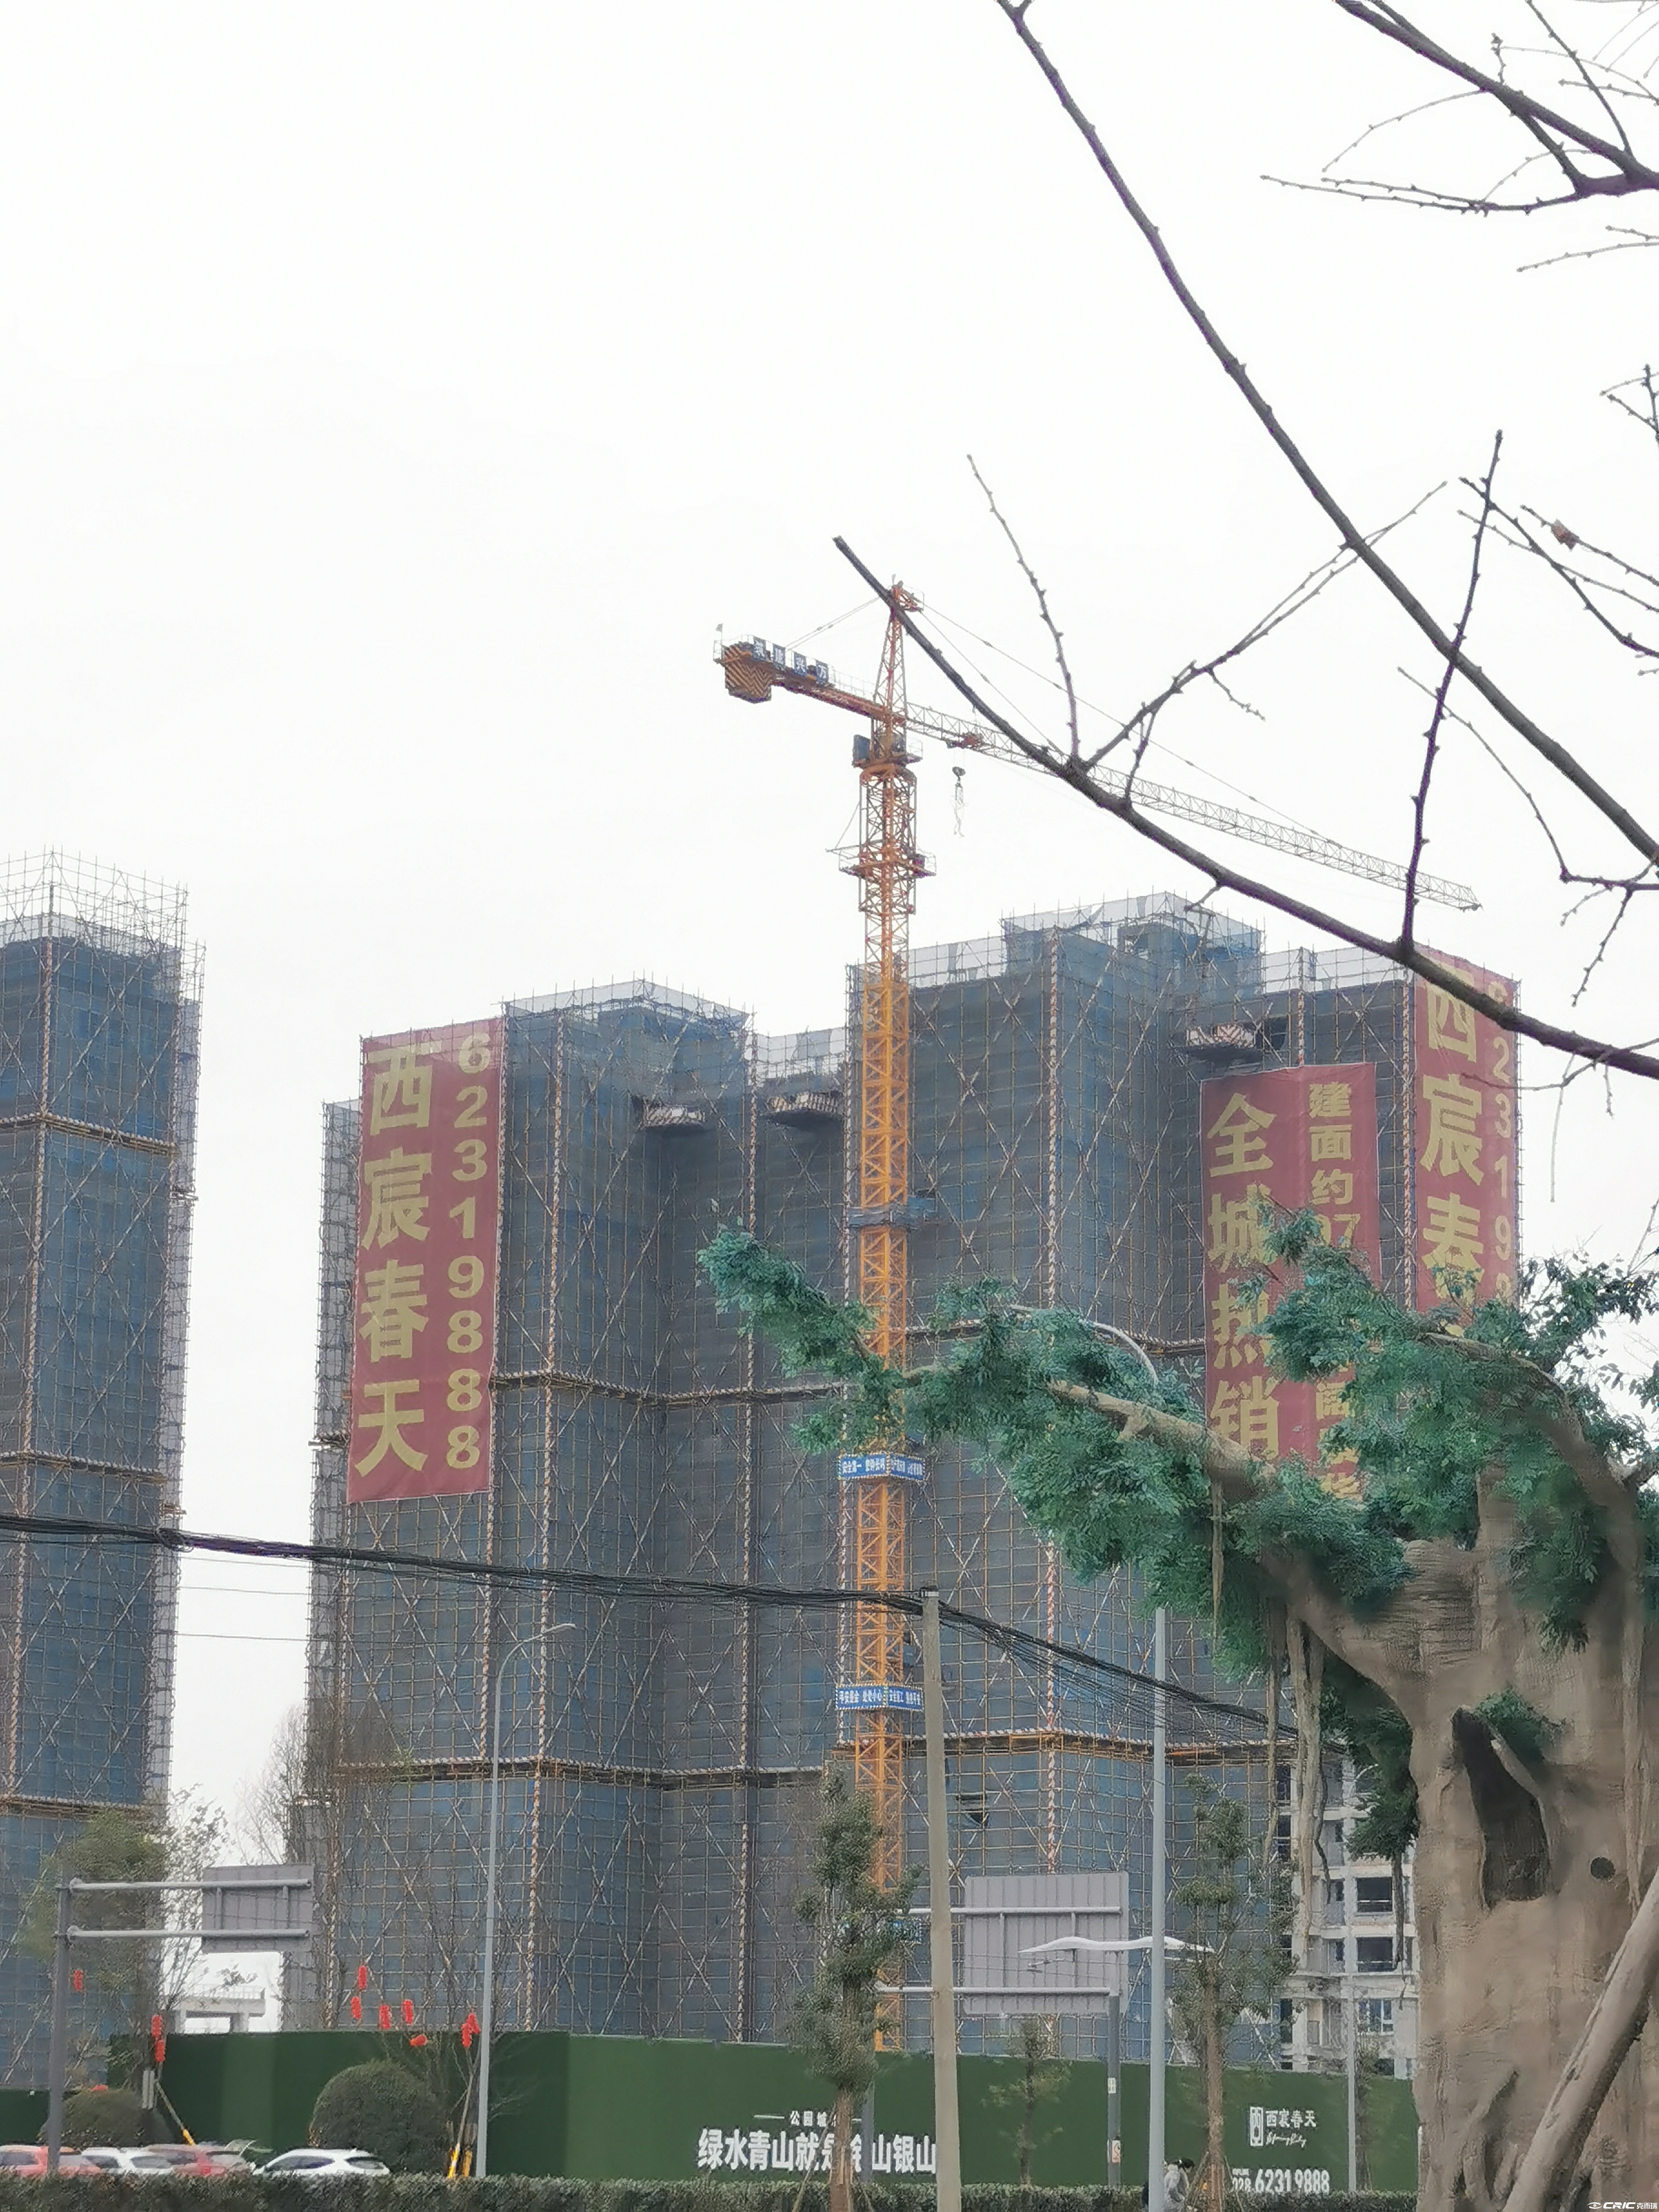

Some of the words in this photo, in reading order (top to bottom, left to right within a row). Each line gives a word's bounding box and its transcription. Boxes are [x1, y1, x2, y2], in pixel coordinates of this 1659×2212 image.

[355, 1040, 438, 1476] 西宸春天
[446, 1033, 491, 1470] 62319888
